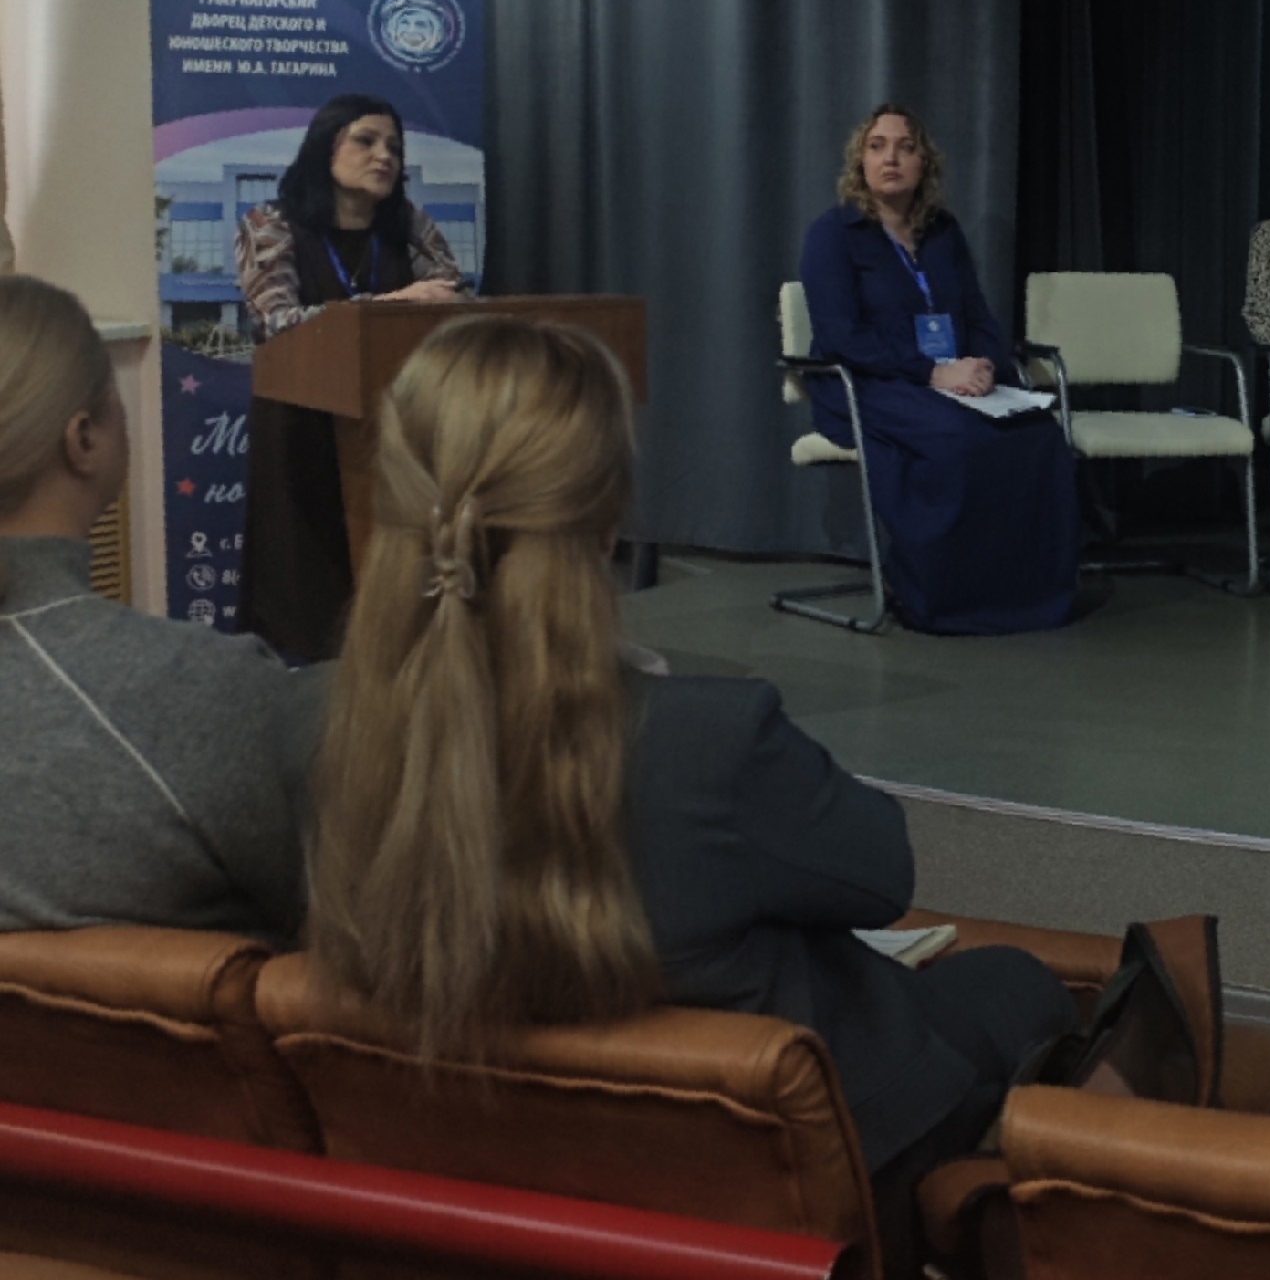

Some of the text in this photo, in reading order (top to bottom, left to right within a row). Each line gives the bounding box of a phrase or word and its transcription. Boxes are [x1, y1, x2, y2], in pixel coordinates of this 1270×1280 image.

[169, 35, 349, 54] ЮНОШЕСКОГО ТВОРЧЕСТВА
[182, 58, 233, 73] ИМЕНИ
[271, 61, 337, 77] ГАГАРИНА
